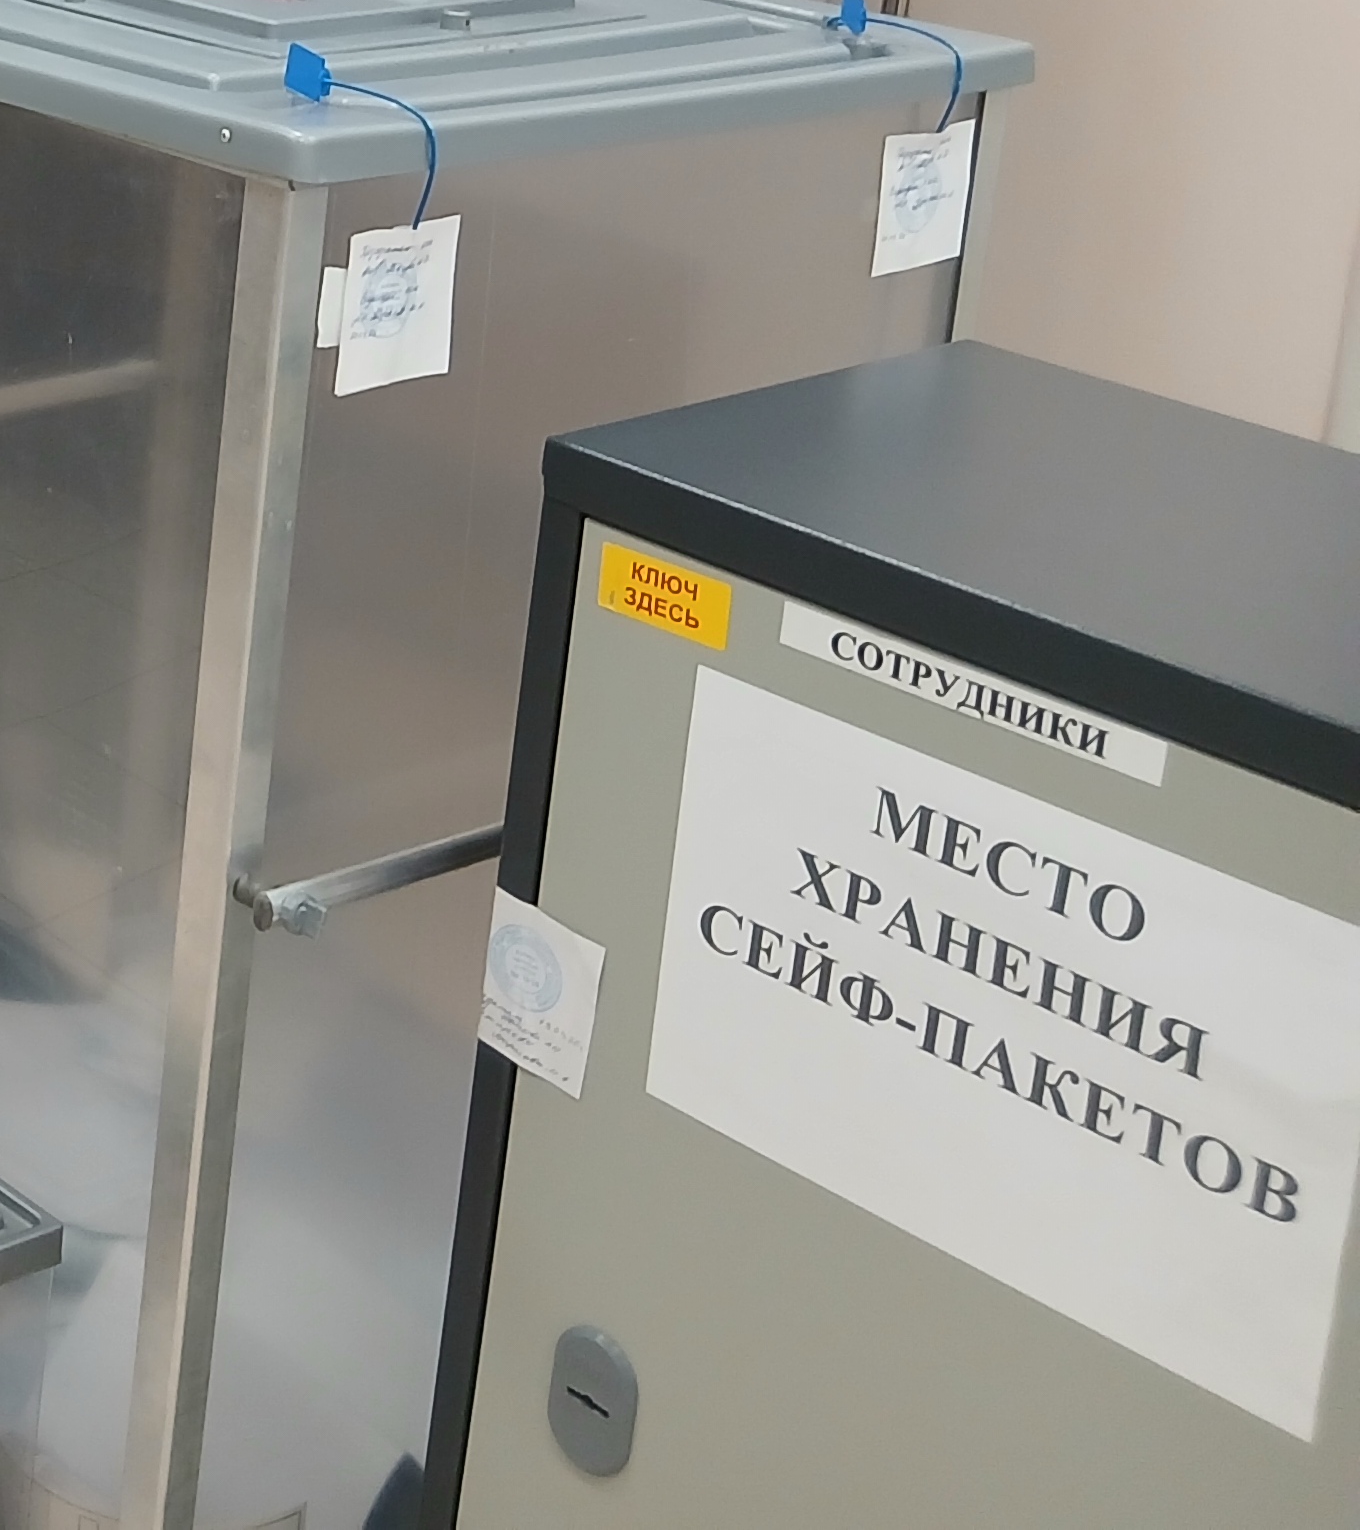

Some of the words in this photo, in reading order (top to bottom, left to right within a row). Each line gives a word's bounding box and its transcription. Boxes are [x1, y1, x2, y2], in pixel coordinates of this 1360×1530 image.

[623, 586, 701, 630] ЗДЕСЬ
[631, 562, 699, 602] КЛЮЧ
[830, 631, 1110, 760] СОТРУДНИКИ
[870, 786, 1146, 943] МЕСТО
[790, 847, 1210, 1080] ХРАНЕНИЯ
[699, 903, 1300, 1224] СЕЙФ-ПАКЕТОВ
